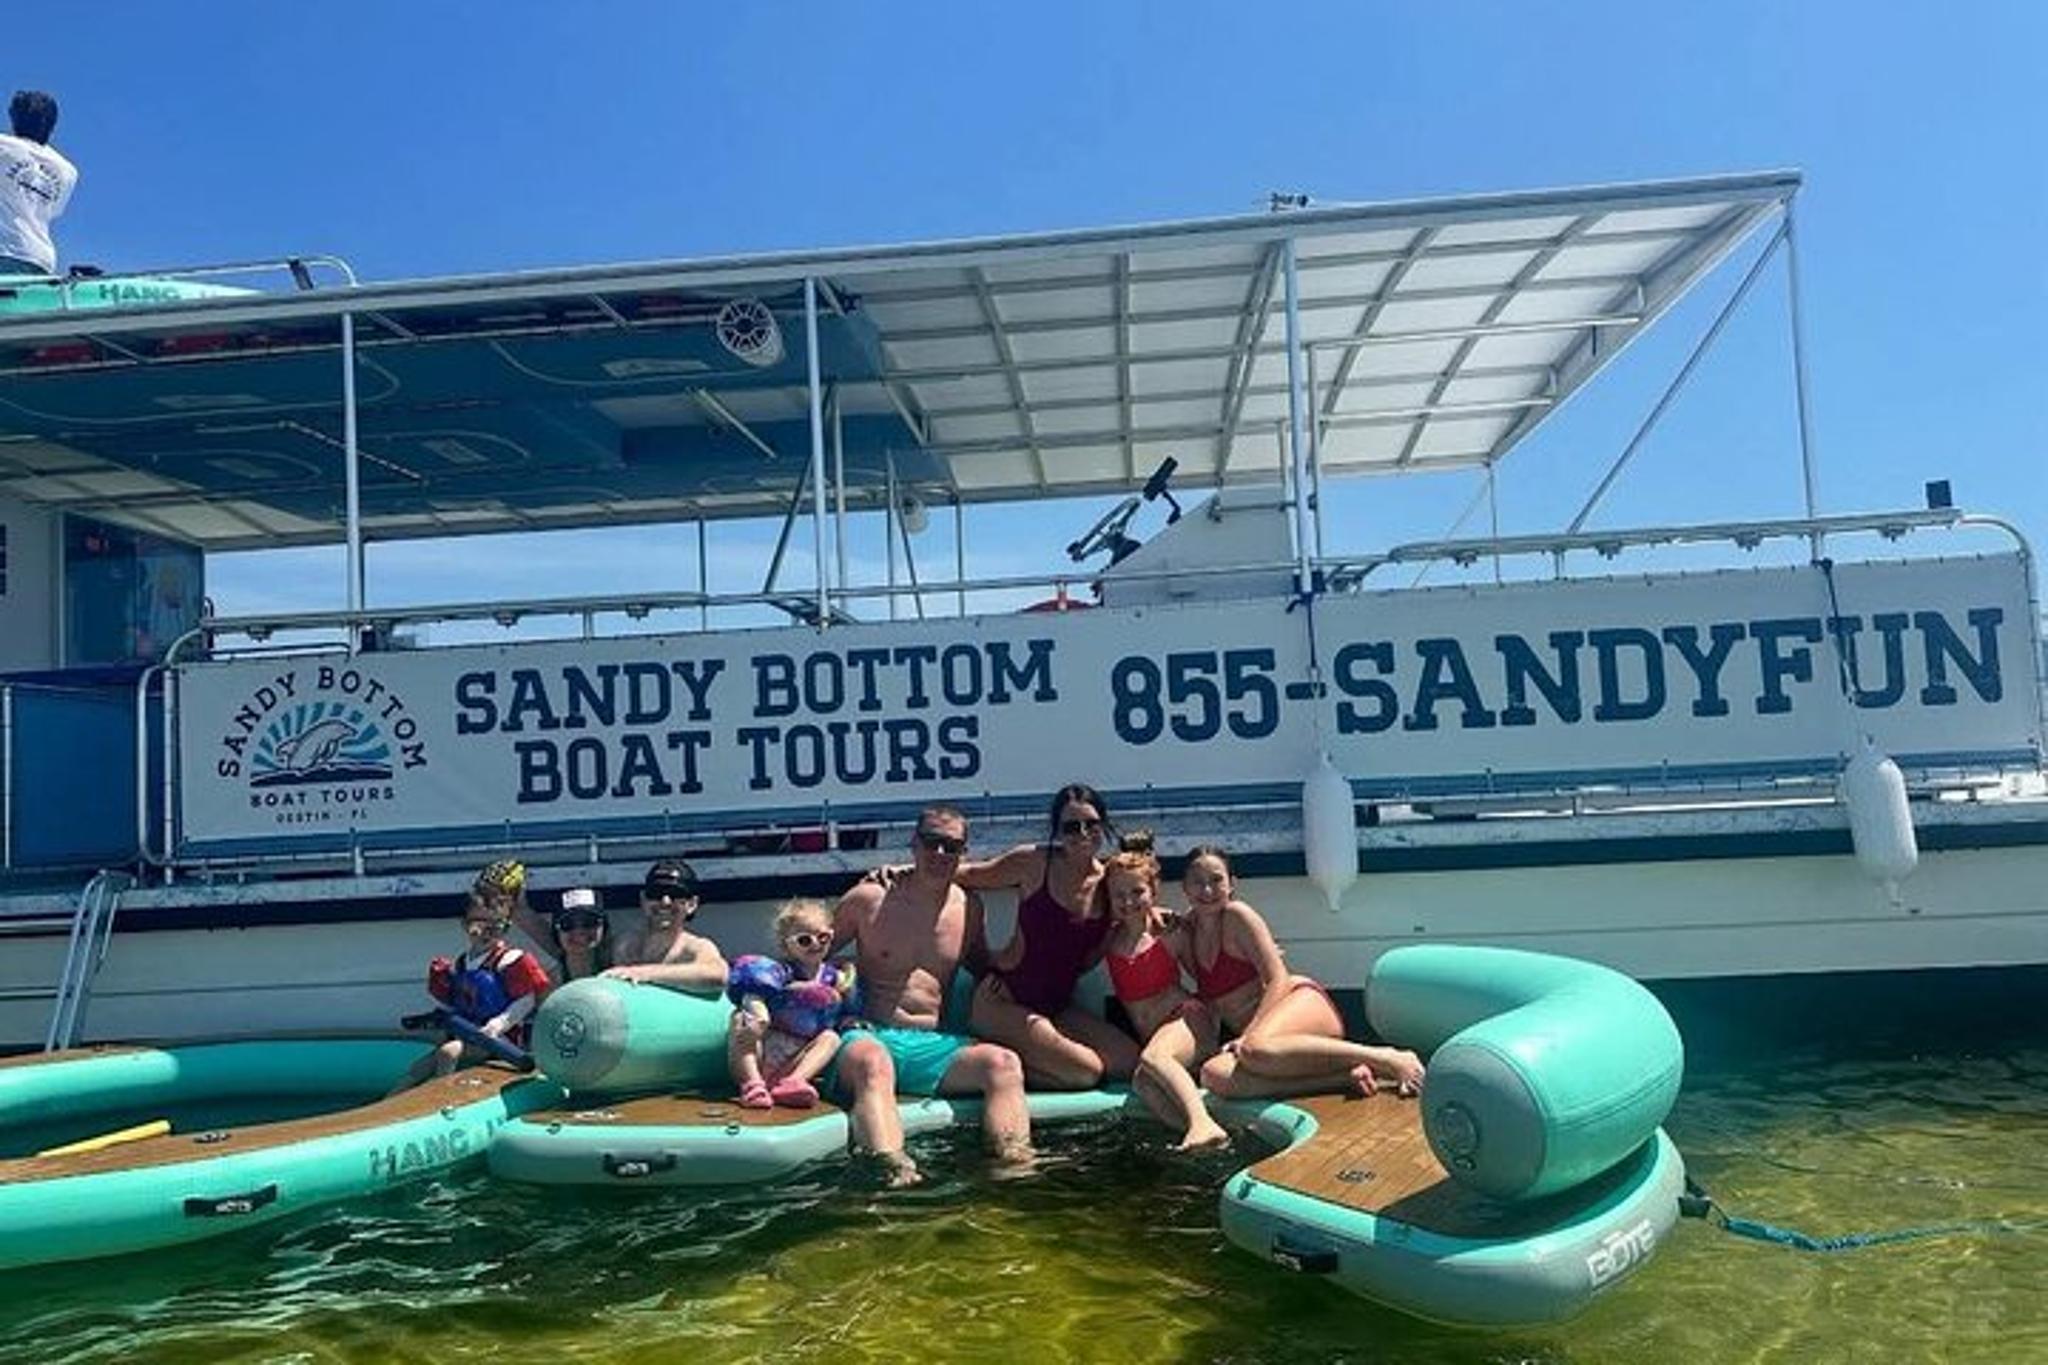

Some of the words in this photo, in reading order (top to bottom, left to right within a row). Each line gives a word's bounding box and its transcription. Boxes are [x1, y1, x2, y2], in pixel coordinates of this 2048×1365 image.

[456, 659, 725, 734] SANDY
[752, 639, 1058, 717] BOTTOM
[1111, 608, 2004, 745] 855-SANDYFUN
[218, 672, 296, 778] SANDY
[318, 667, 428, 770] BOTTOM
[514, 730, 711, 803] BOAT
[737, 715, 981, 790] TOURS
[250, 792, 306, 808] BOAT
[321, 787, 394, 803] TOURS
[369, 1128, 470, 1179] HANG
